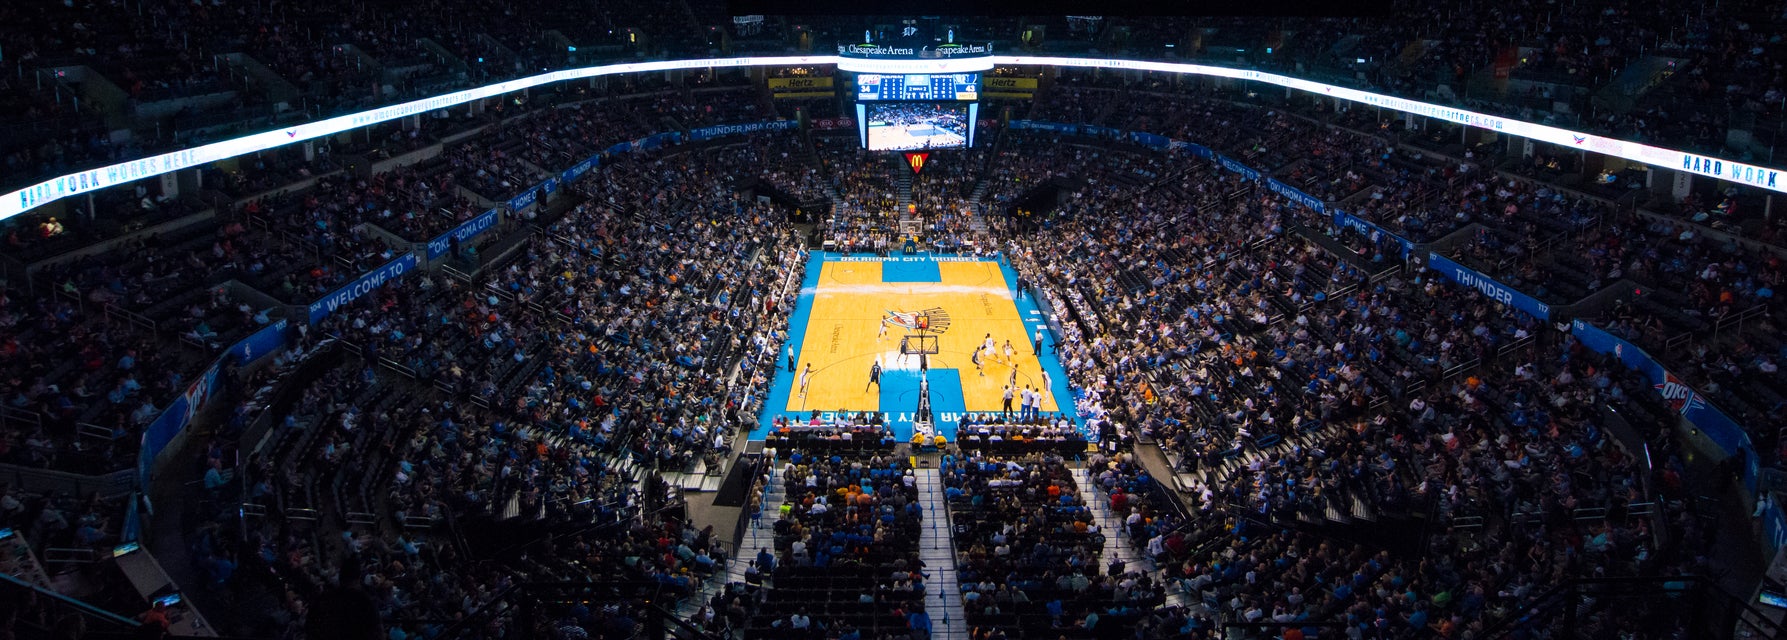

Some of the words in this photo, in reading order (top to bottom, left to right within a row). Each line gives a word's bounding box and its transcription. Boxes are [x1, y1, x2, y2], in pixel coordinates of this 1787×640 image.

[849, 44, 888, 57] Chesapeake
[888, 45, 914, 55] Arena
[968, 45, 984, 53] Arena
[1222, 159, 1246, 175] WELCOME
[1683, 154, 1722, 175] HARD
[1731, 163, 1778, 188] WORK
[20, 186, 51, 208] HARD
[56, 171, 99, 193] WORK
[107, 157, 156, 183] WORKS
[515, 192, 531, 209] HOME
[1270, 181, 1302, 202] OKLAHOMA
[1304, 197, 1319, 211] CITY
[434, 222, 477, 254] OKLHOMA
[478, 213, 494, 229] CITY
[1344, 217, 1367, 236] HOME
[326, 271, 386, 312] WELCOME
[389, 262, 403, 277] TO
[1455, 268, 1513, 305] THUNDER
[1538, 303, 1549, 313] 117
[1574, 319, 1585, 330] 118
[1662, 381, 1688, 400] OKC
